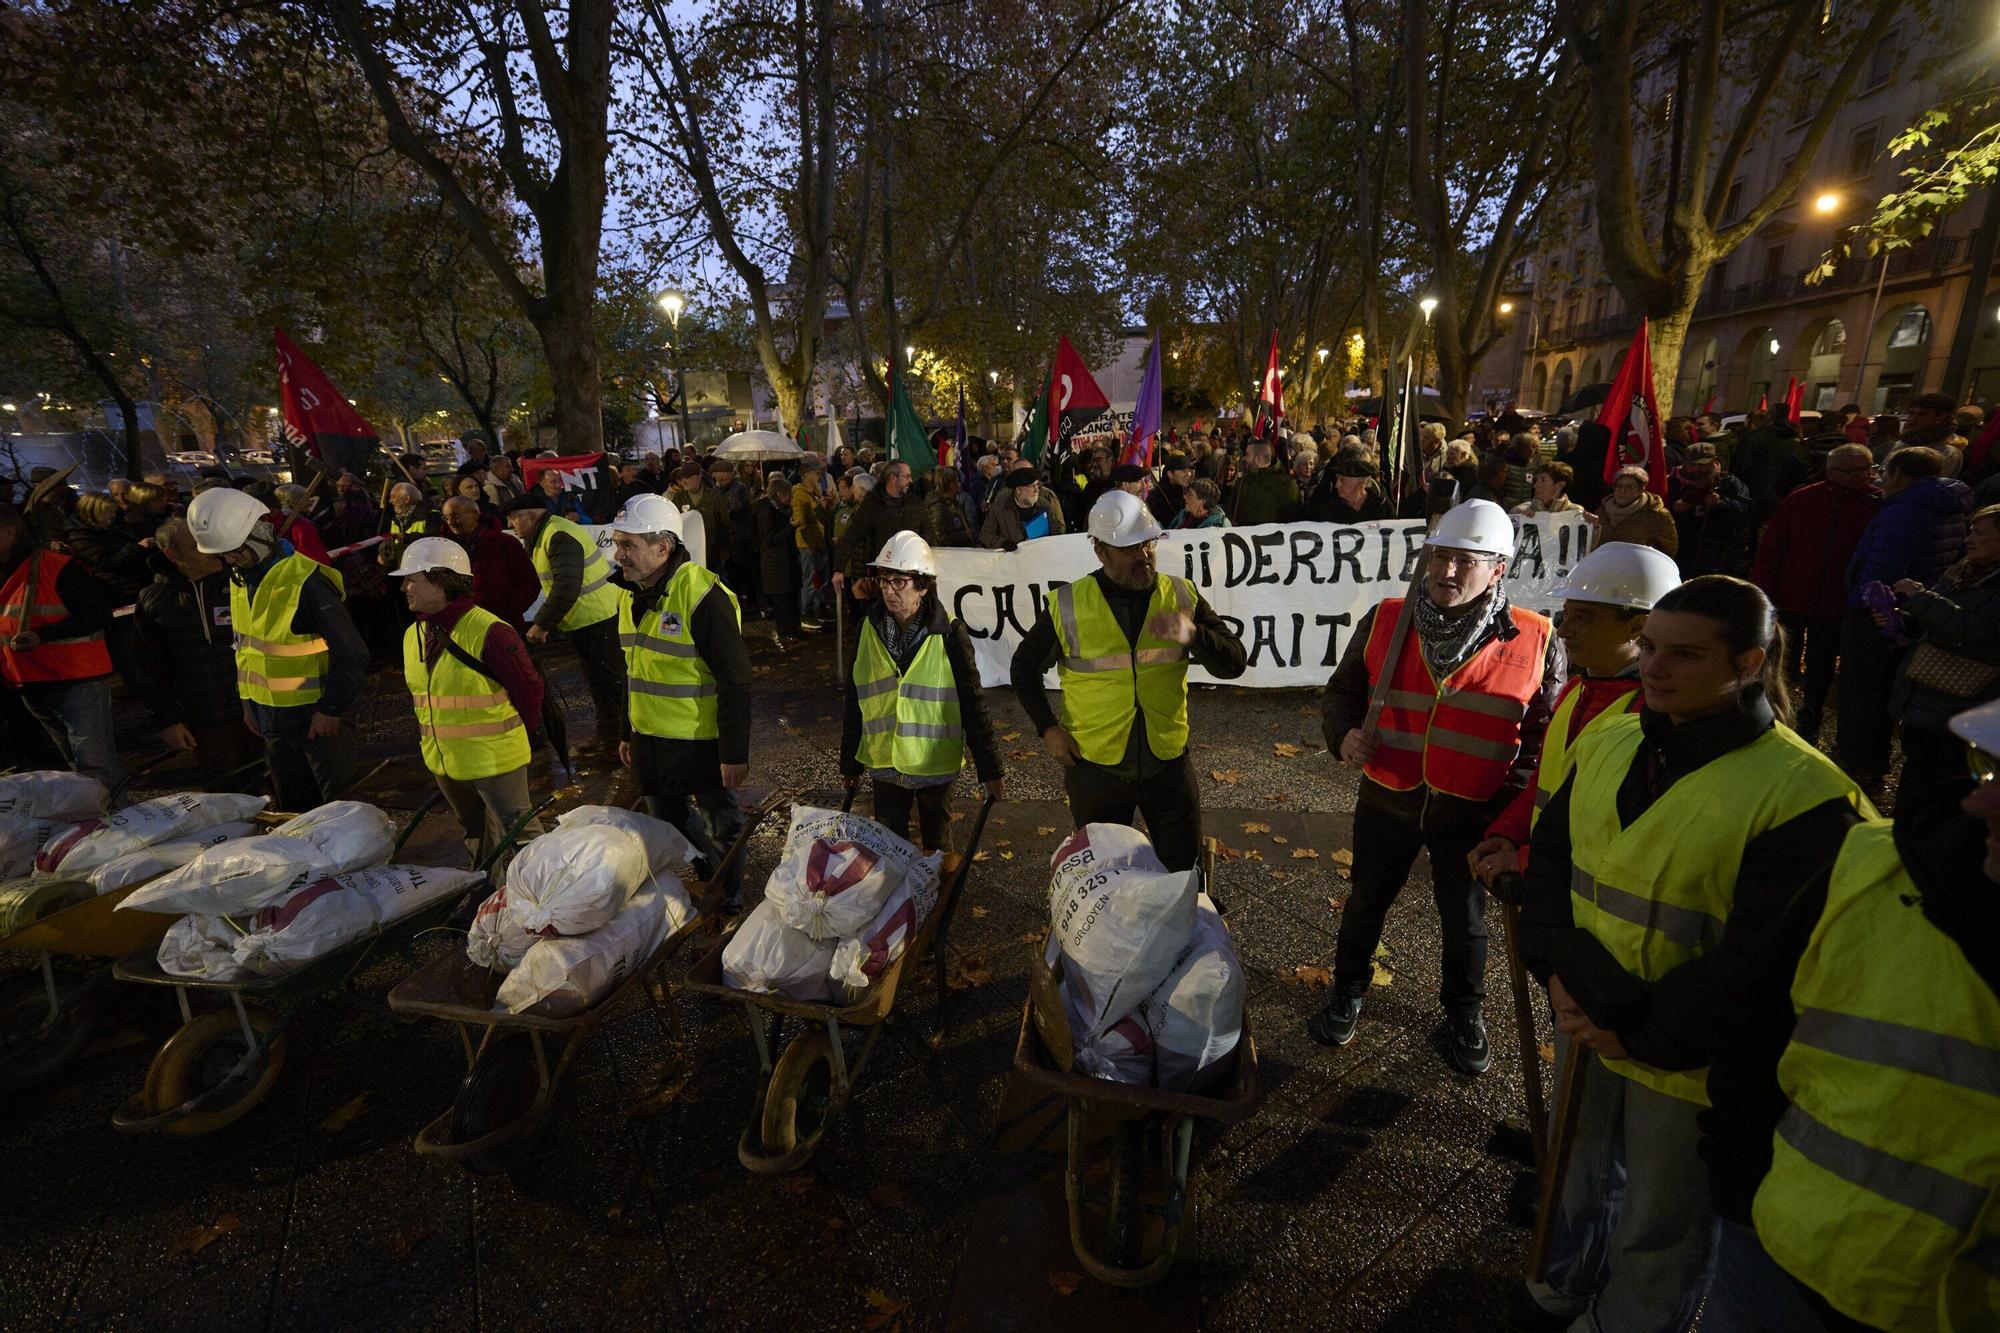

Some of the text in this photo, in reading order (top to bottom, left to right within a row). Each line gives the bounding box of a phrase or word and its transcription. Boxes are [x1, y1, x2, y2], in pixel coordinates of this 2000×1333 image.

[558, 466, 599, 492] NT
[1184, 523, 1588, 588] ¡¡DERRI A!!
[1061, 899, 1079, 932] 948
[1077, 872, 1108, 900] 325
[1073, 893, 1110, 947] ORCOYEN
